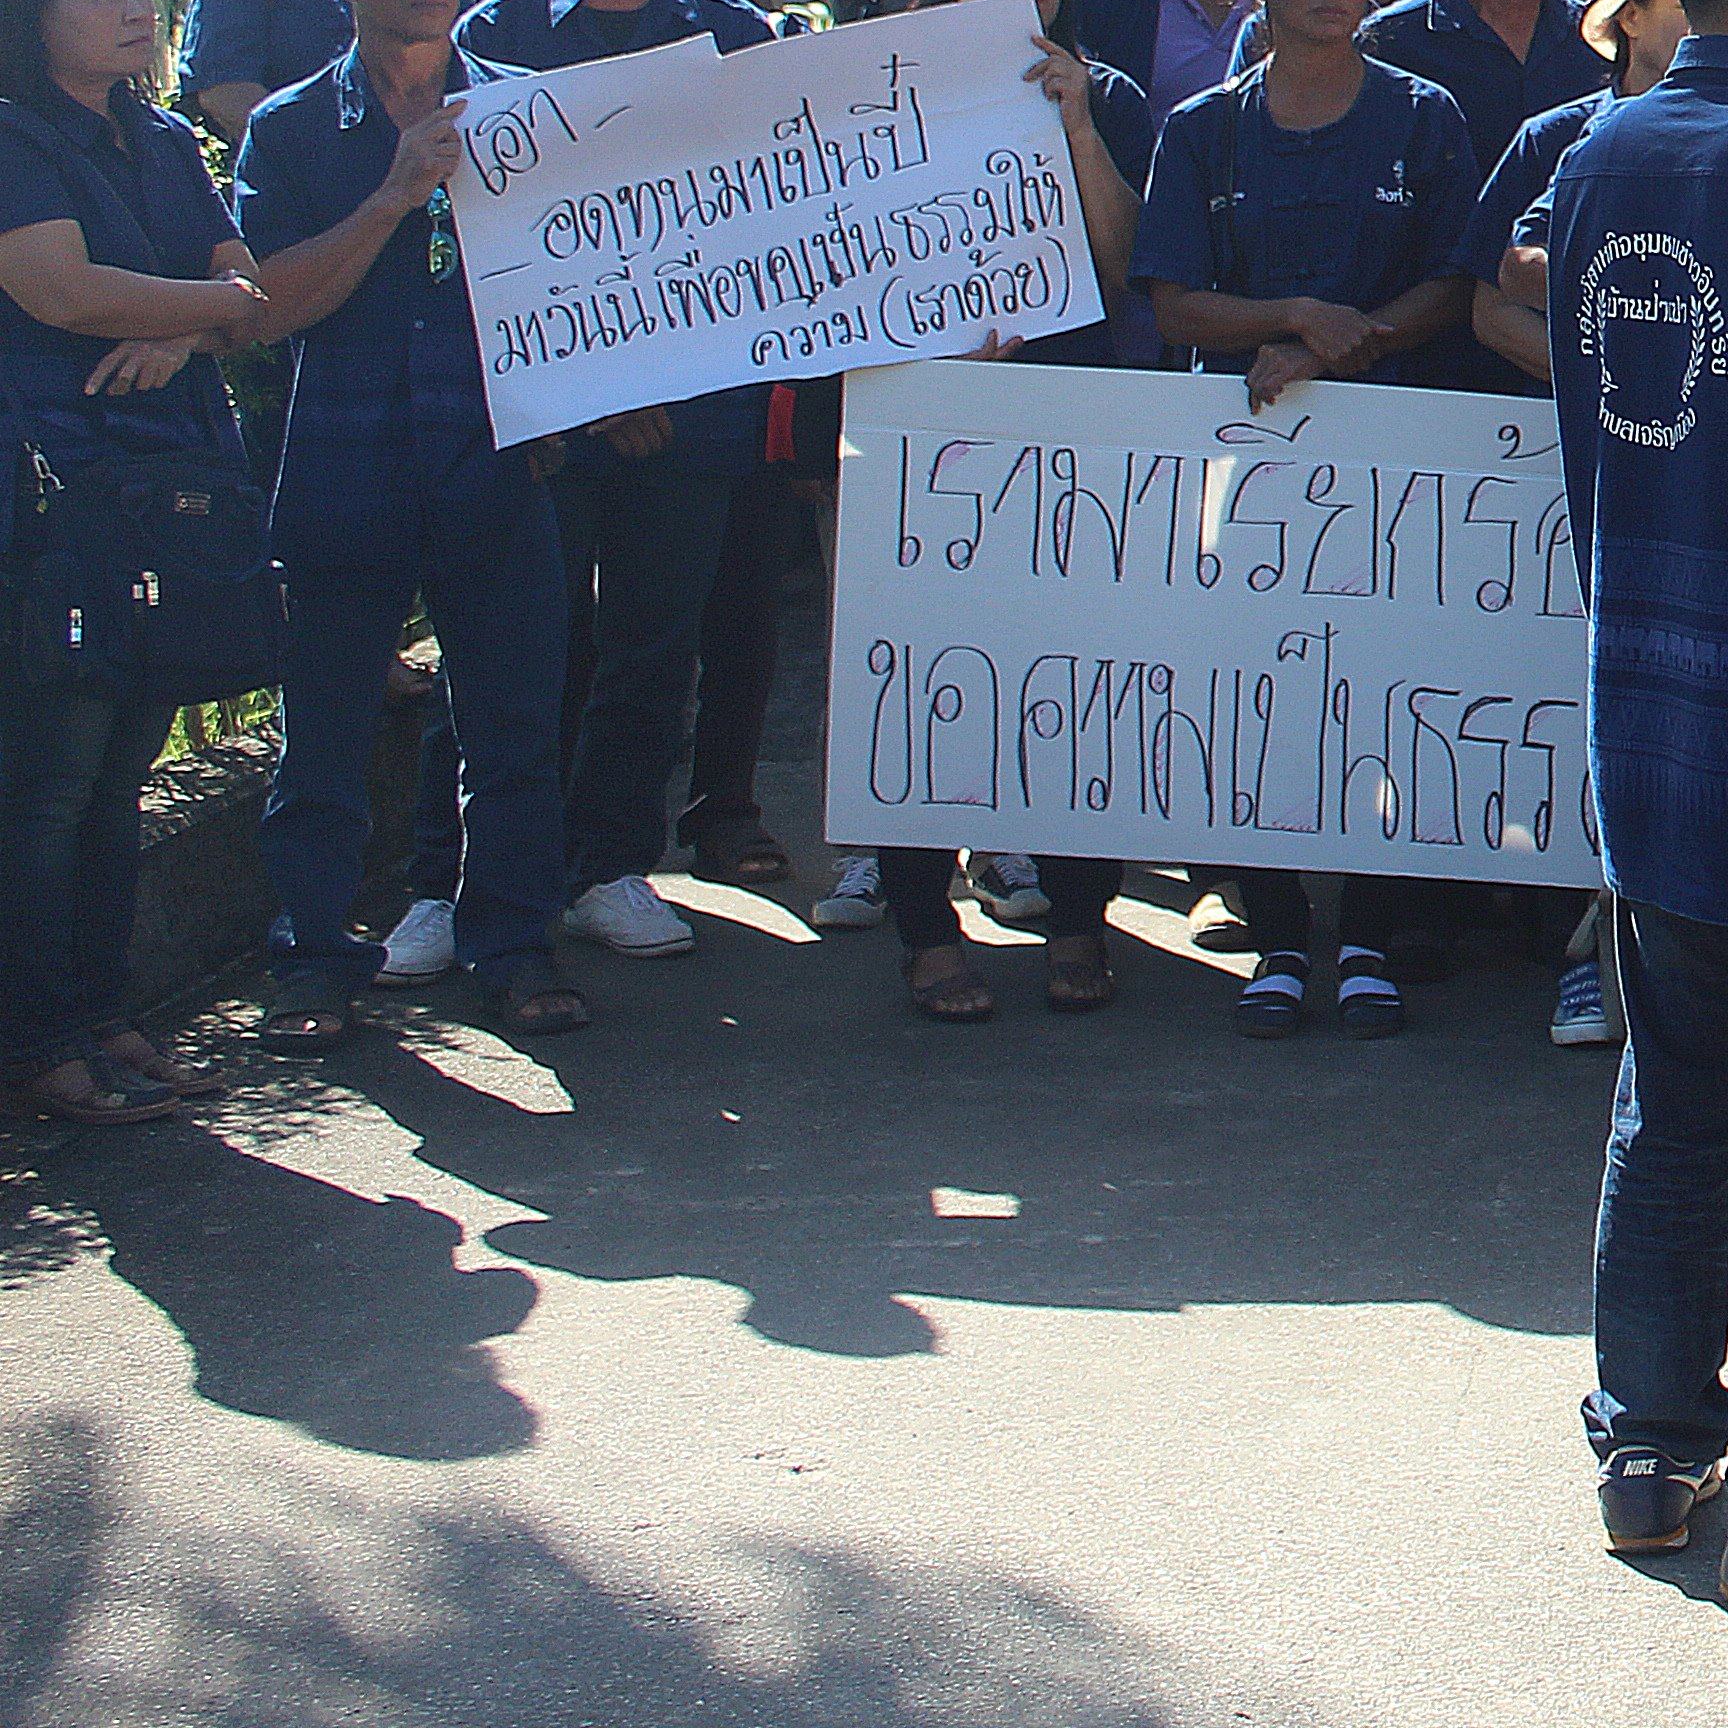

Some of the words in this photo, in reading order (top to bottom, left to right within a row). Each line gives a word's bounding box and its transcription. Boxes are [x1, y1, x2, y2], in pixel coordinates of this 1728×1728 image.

[752, 304, 872, 367] ความ
[867, 622, 1600, 852] ขอความเป็นธรร
[1622, 1458, 1659, 1477] NIKE
